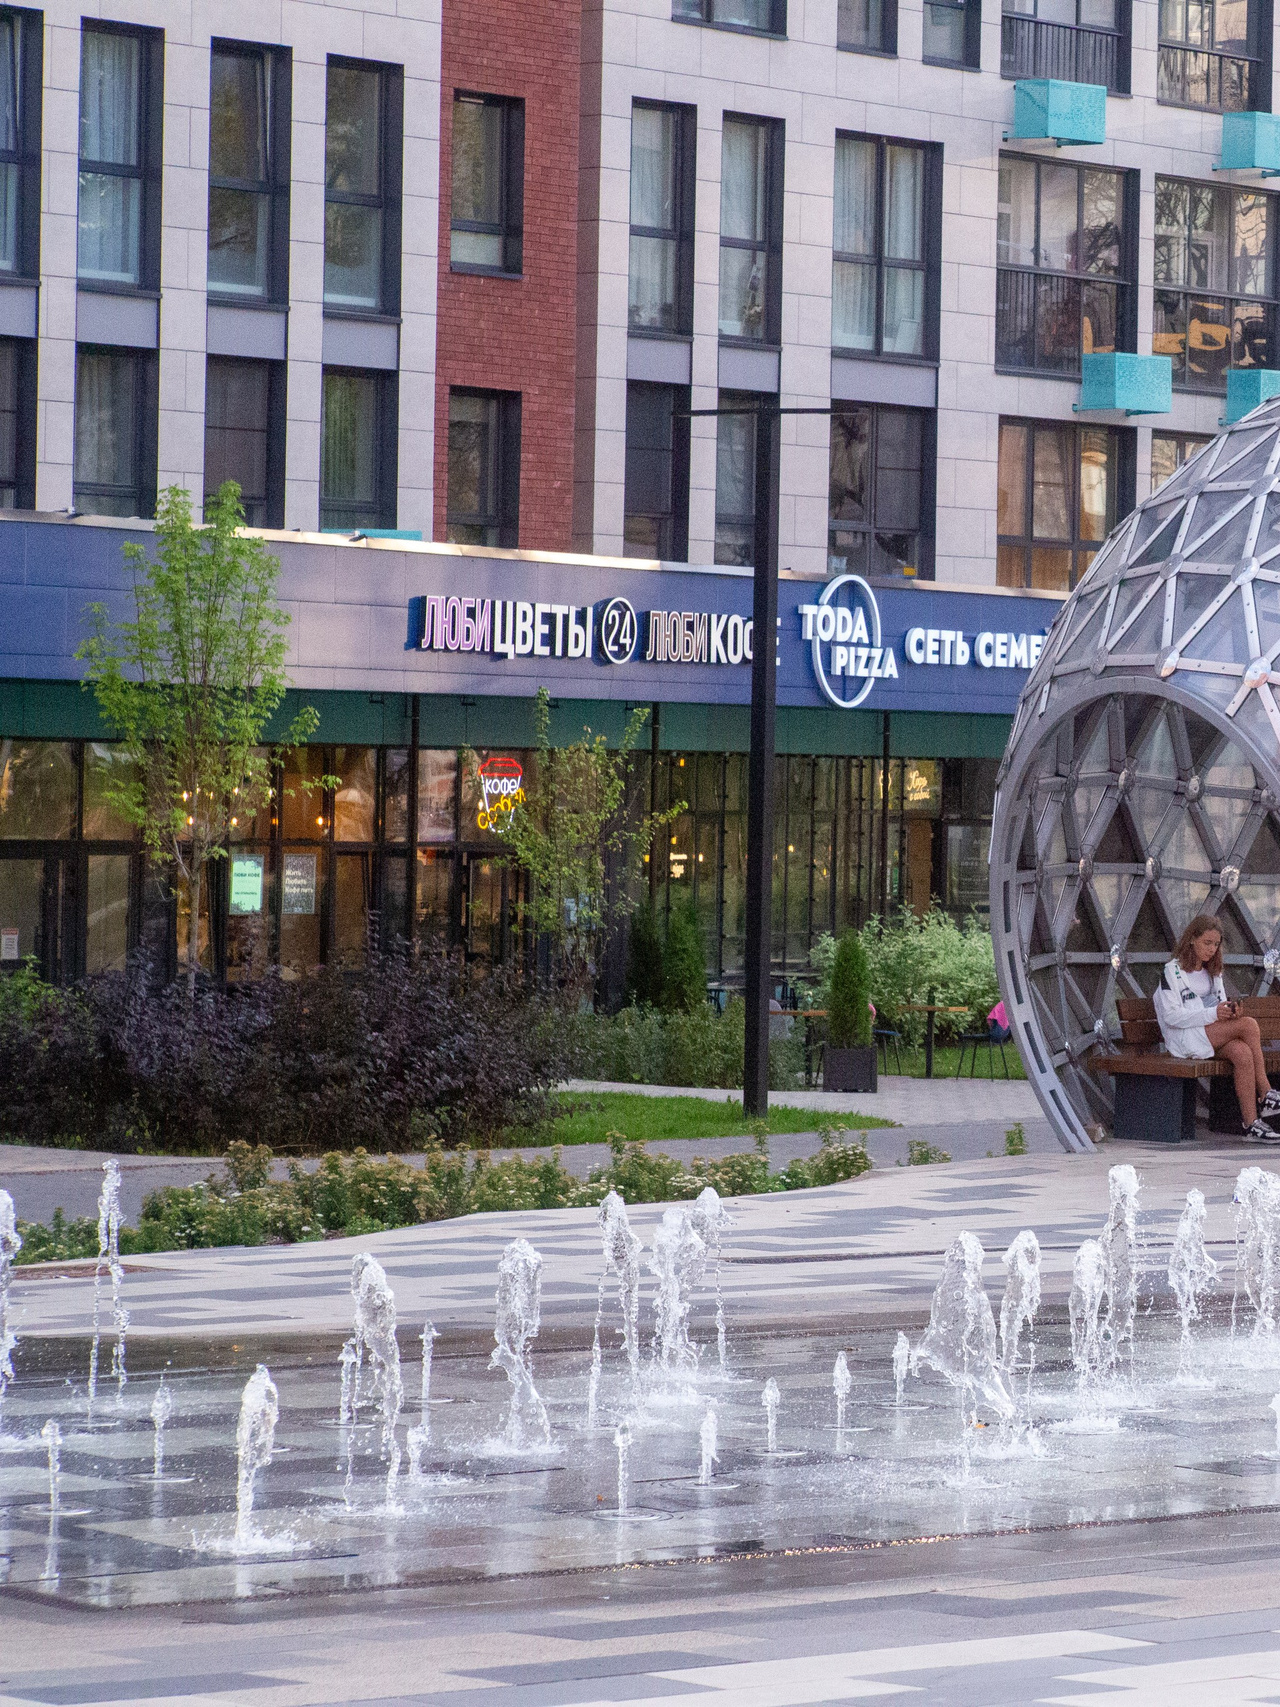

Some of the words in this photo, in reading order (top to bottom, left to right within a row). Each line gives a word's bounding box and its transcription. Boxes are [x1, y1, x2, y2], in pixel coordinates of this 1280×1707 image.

[608, 609, 632, 653] 24
[801, 604, 869, 645] TODA
[833, 645, 899, 678] PIZZA
[907, 627, 970, 665] СЕТЬ
[977, 631, 1048, 669] СЕМЕ
